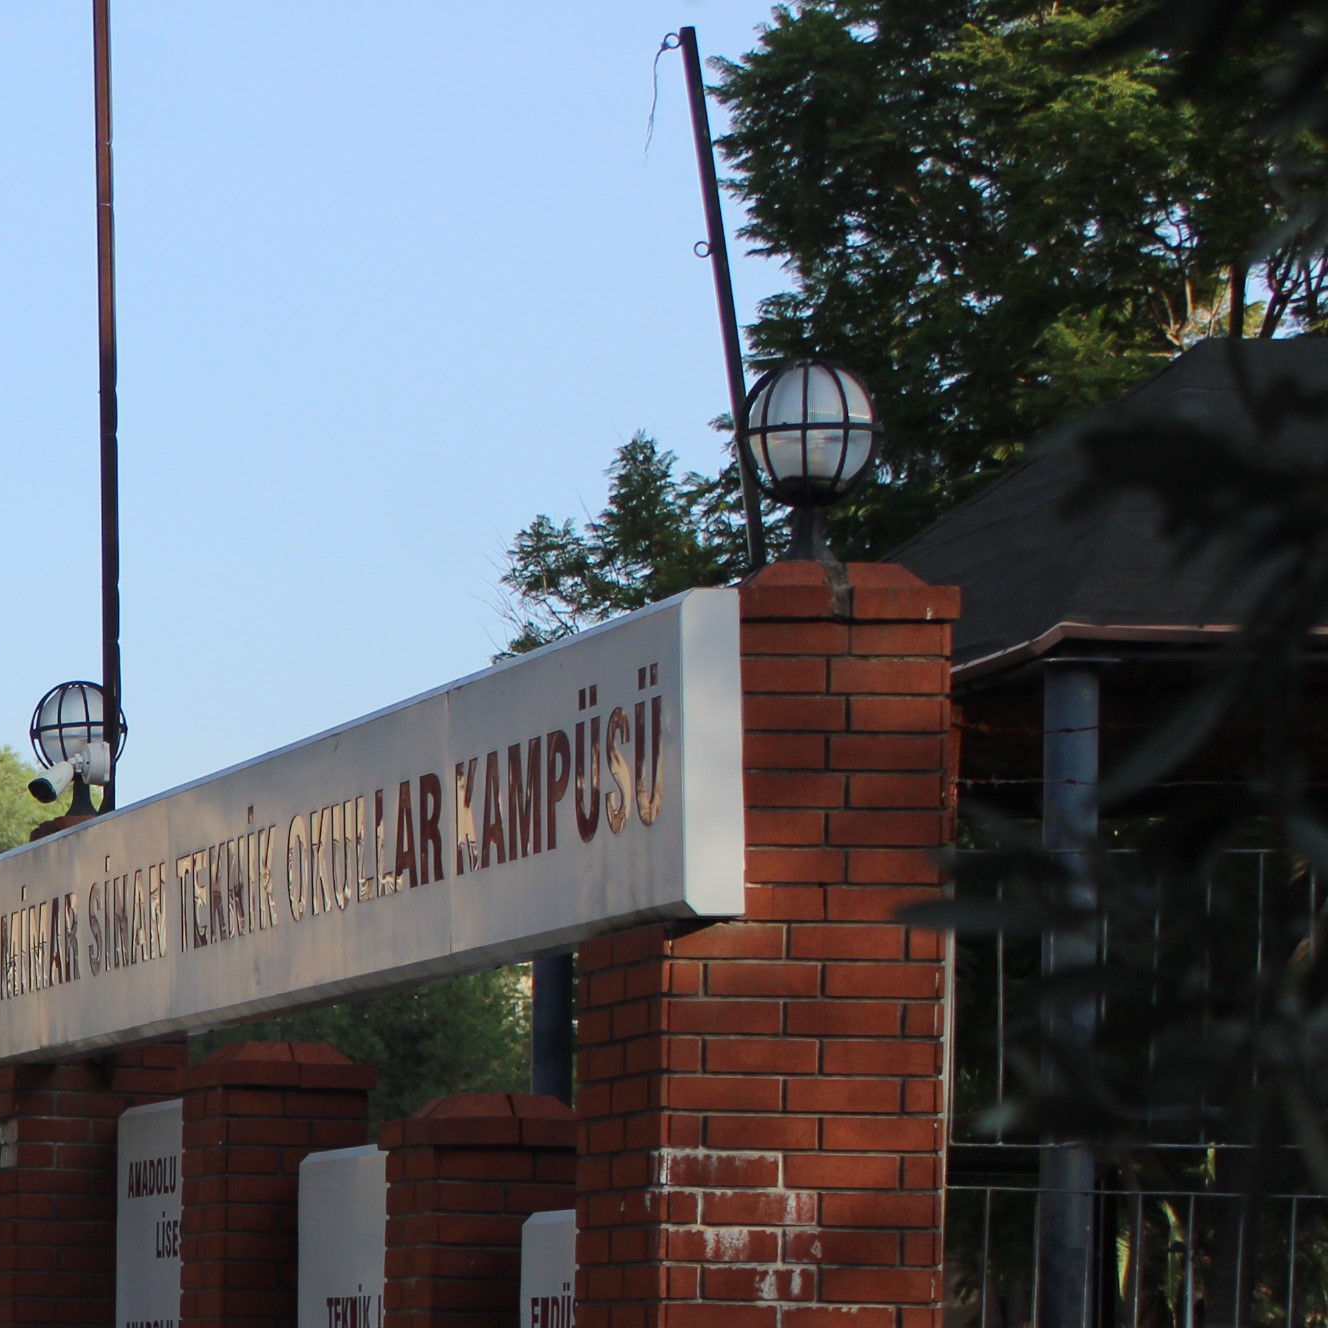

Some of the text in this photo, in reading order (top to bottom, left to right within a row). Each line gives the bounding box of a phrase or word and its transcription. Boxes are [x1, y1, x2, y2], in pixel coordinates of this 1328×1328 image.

[0, 662, 666, 1000] MİMAR SİNAN TEKNİK OKULLAR KAMPÜSÜ
[128, 1156, 176, 1198] ANADOLU
